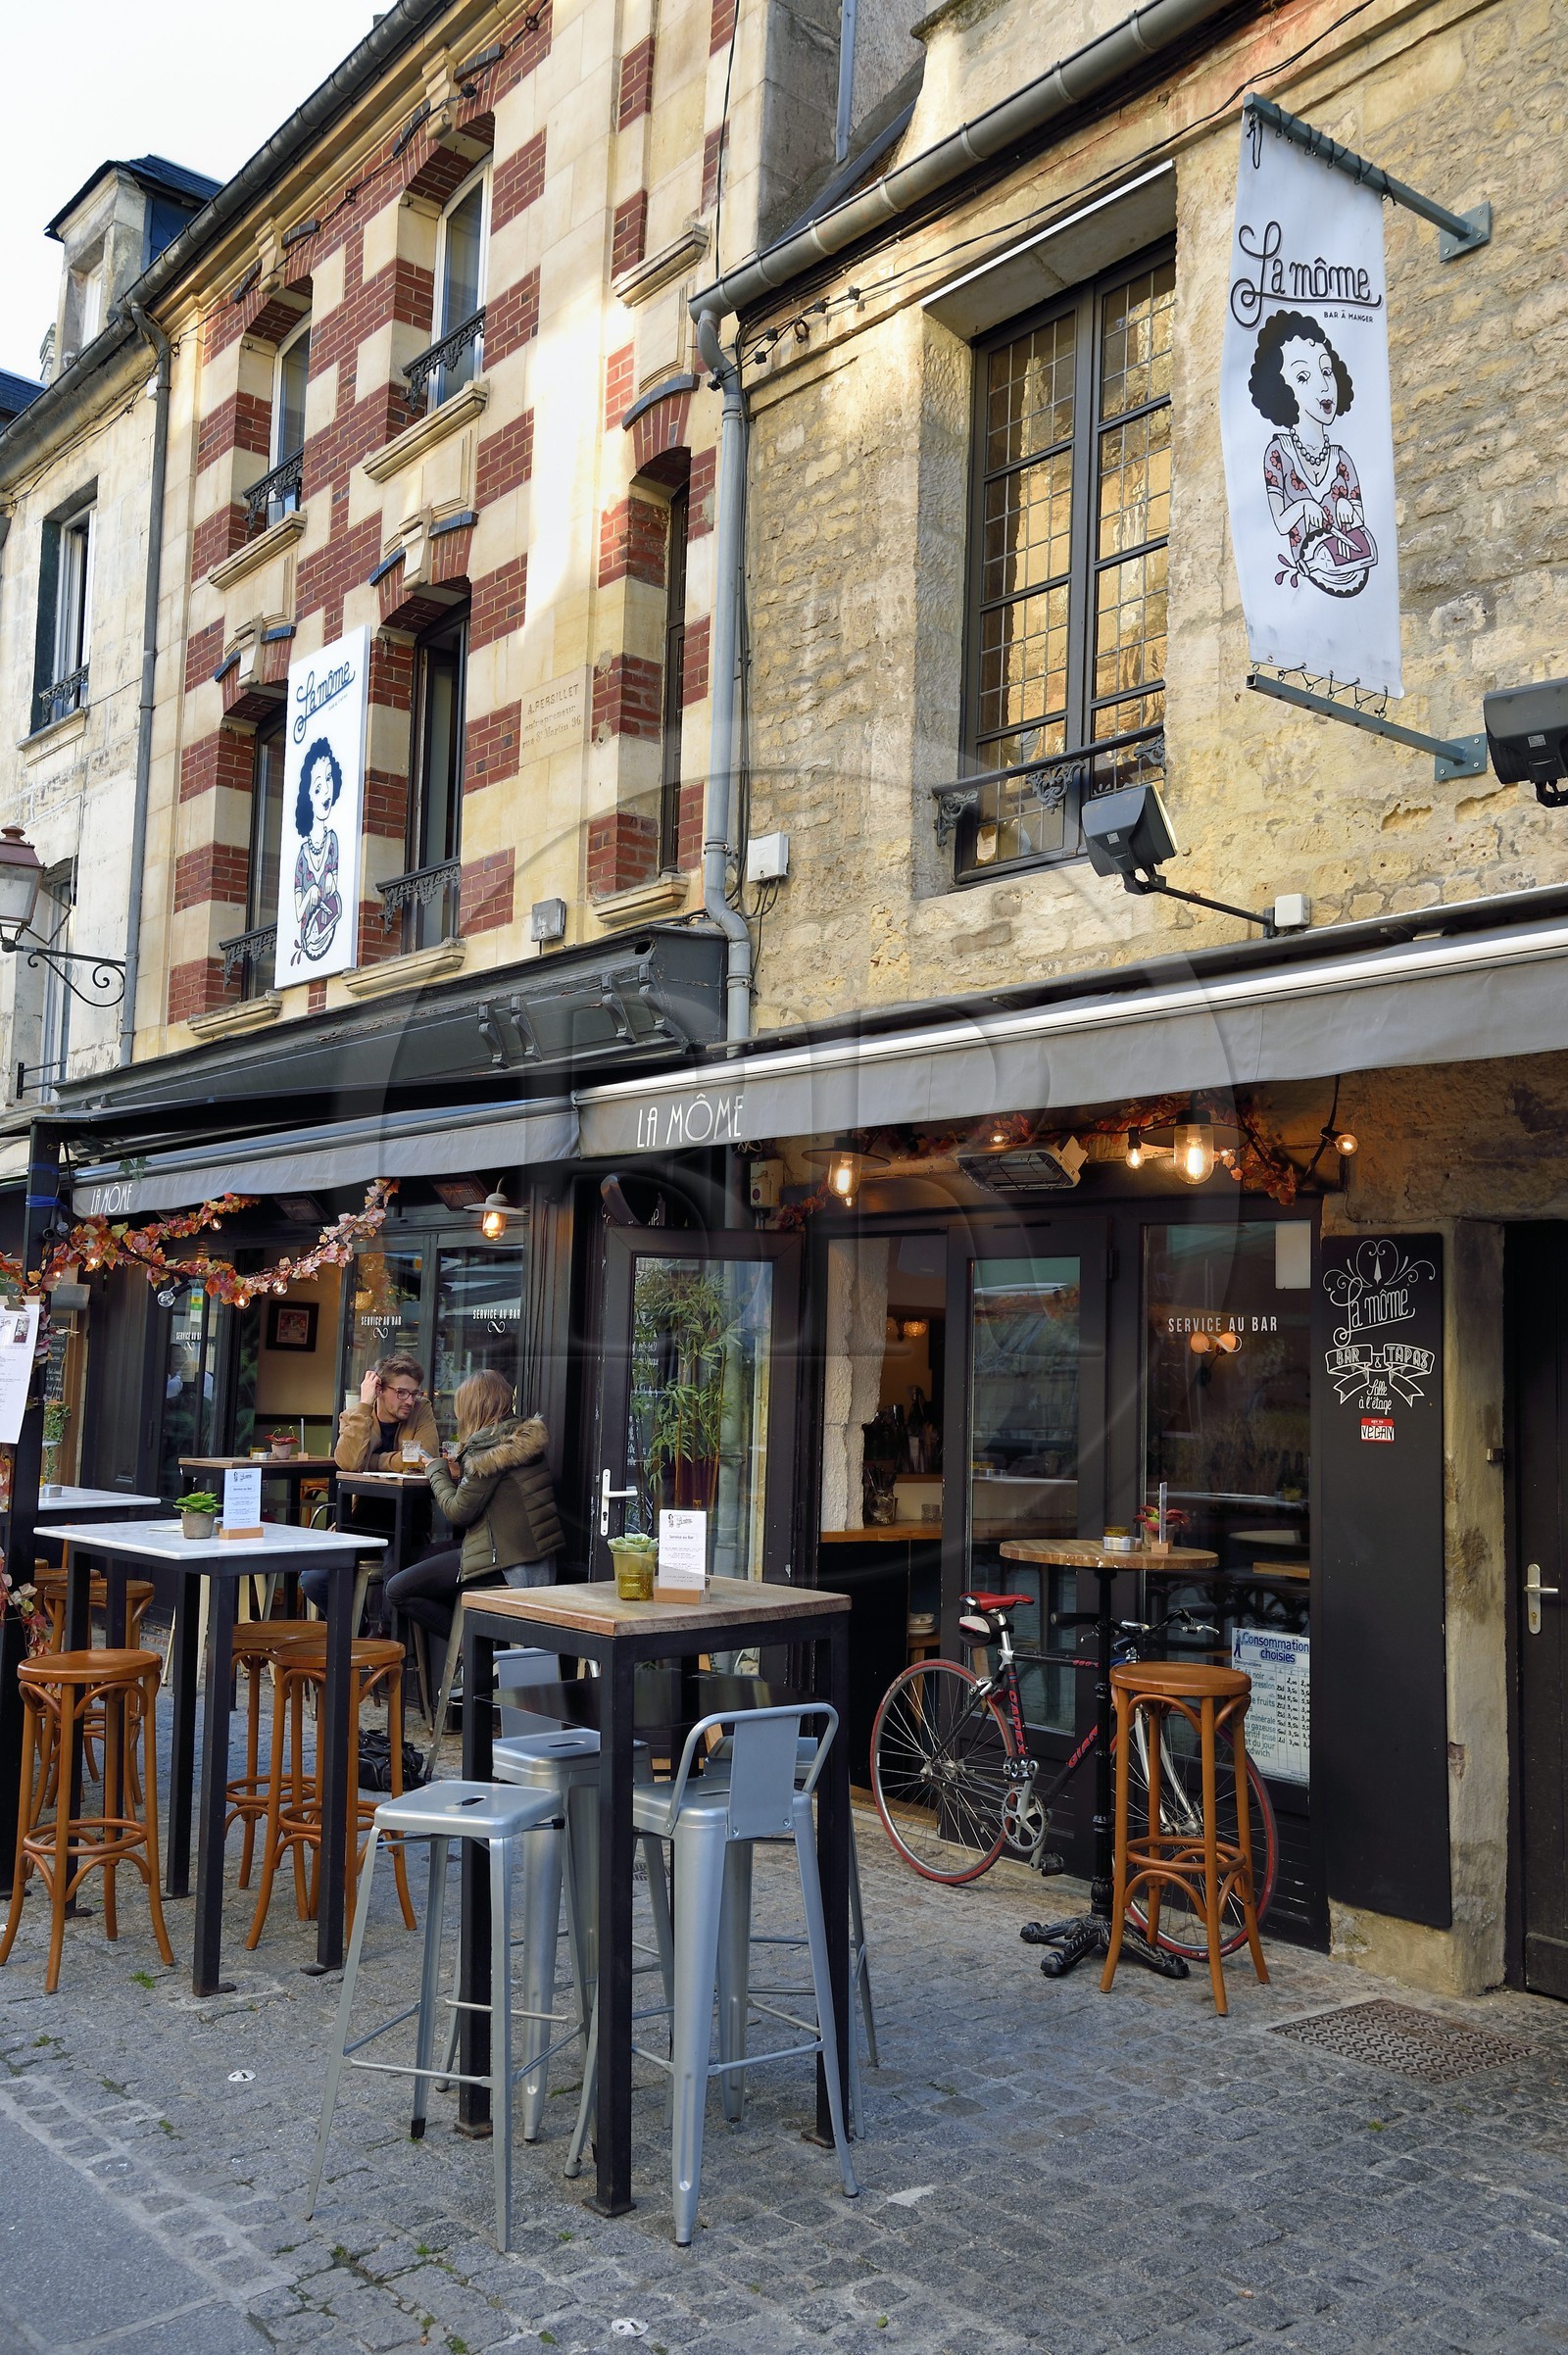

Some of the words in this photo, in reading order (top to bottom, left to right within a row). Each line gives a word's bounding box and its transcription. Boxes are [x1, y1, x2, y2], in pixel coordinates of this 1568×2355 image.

[1230, 221, 1286, 328] La
[1289, 256, 1372, 302] môme
[1348, 313, 1374, 323] MANGER
[293, 670, 318, 745] La
[317, 661, 351, 706] môme
[524, 705, 576, 732] entrepreneur
[521, 737, 535, 750] rue
[544, 722, 568, 740] Martin
[637, 1106, 659, 1149] LA
[665, 1092, 745, 1146] MÔME
[90, 1188, 102, 1215] LA
[100, 1181, 133, 1213] MÔME
[361, 1315, 381, 1326] SERVICE
[382, 1315, 390, 1326] AU
[391, 1315, 402, 1326] BAR
[473, 1308, 497, 1320] SERVICE
[499, 1308, 508, 1320] AU
[509, 1308, 521, 1320] BAR
[1330, 1277, 1363, 1348] La
[1364, 1289, 1409, 1324] môme
[1168, 1316, 1222, 1333] SERVICE
[1228, 1316, 1245, 1332] AU
[1251, 1315, 1278, 1332] BAR
[1336, 1348, 1360, 1366] BAR
[1374, 1355, 1382, 1369] &
[1386, 1346, 1430, 1370] TAPAS
[1366, 1378, 1389, 1398] Salle
[1358, 1396, 1365, 1409] à
[1365, 1396, 1393, 1416] l'étage
[1260, 1647, 1296, 1663] choisies
[1252, 1671, 1265, 1680] noir
[1256, 1696, 1276, 1707] fruits
[1300, 1689, 1310, 1697] 3,5
[1008, 1690, 1027, 1756] CADEX
[1250, 1713, 1276, 1725] minérale
[1251, 1723, 1277, 1734] gazeuse
[1247, 1747, 1271, 1757] ndwich
[1260, 1741, 1276, 1750] jour
